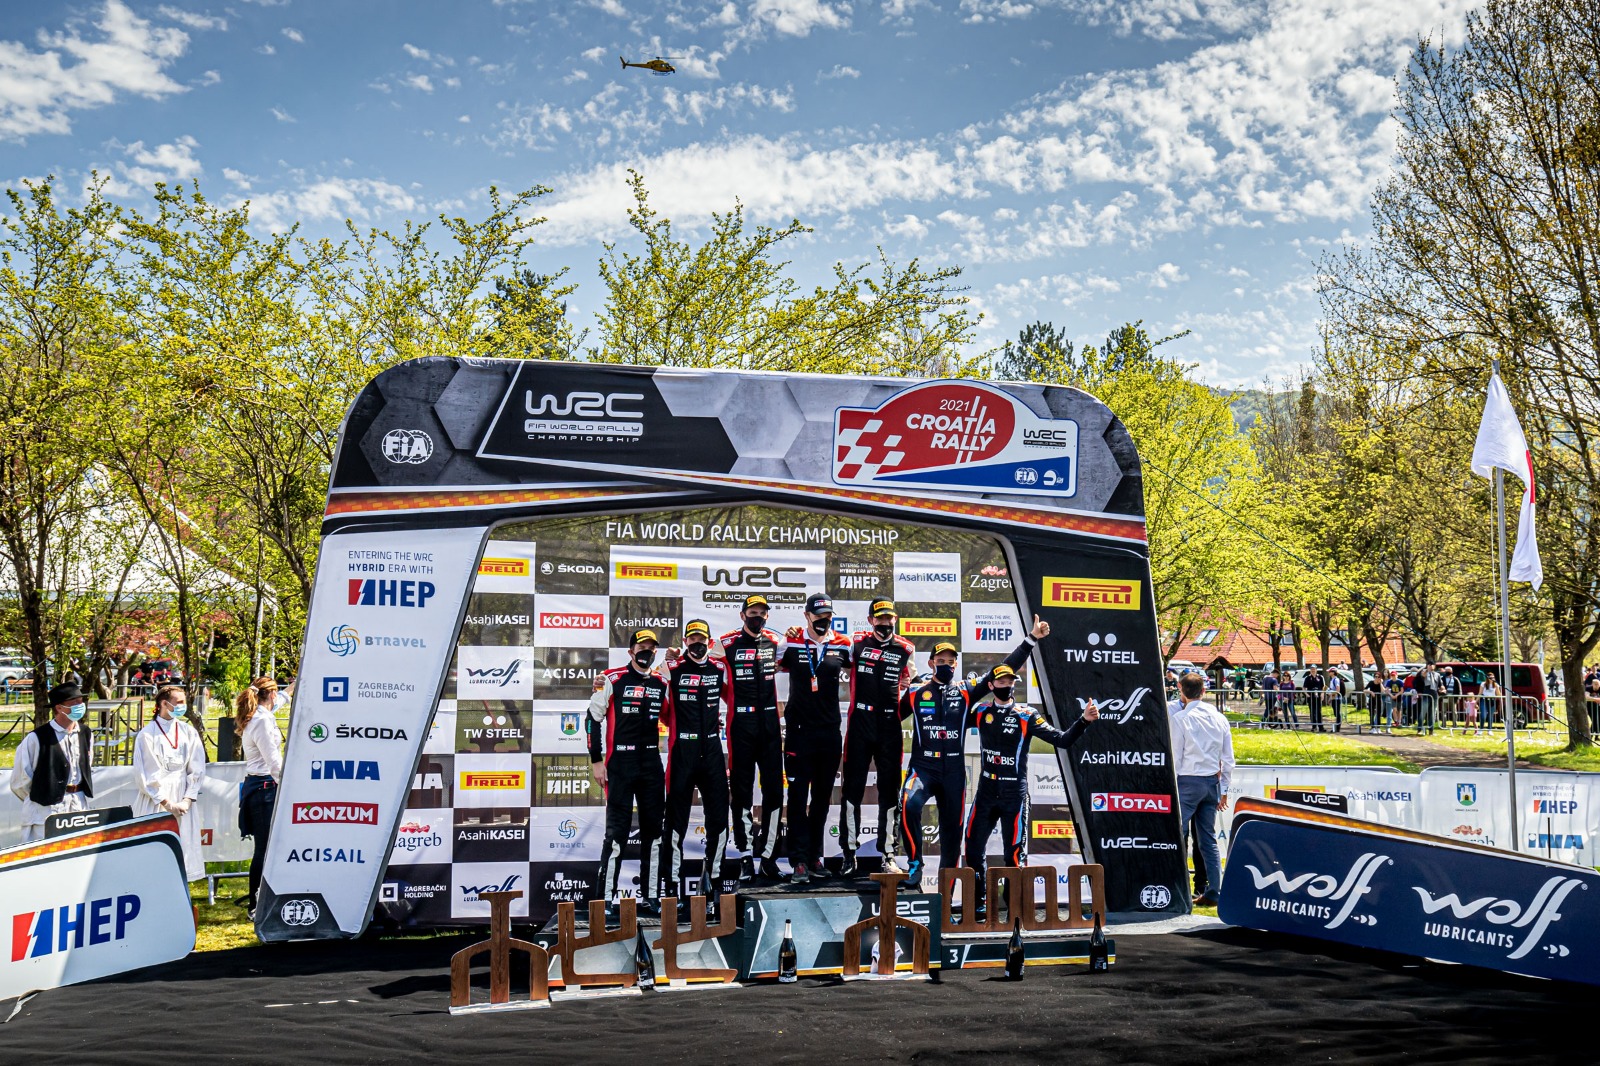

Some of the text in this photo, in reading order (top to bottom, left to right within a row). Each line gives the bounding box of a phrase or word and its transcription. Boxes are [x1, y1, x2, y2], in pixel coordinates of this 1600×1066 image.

[525, 390, 645, 418] WRC
[939, 399, 970, 412] 2021
[528, 422, 641, 433] FIA WORLD RALLY
[906, 413, 996, 434] CROATIA
[527, 434, 640, 443] CHAMPIONSHIP
[1023, 428, 1067, 441] WRC
[930, 433, 996, 452] RALLY
[606, 522, 899, 545] FIA WORLD RALLY CHAMPIONSHIP
[348, 550, 433, 562] ENTERING THE WRC
[348, 563, 433, 574] HYBRID ERA WITH
[479, 561, 524, 573] IRELLI
[558, 564, 604, 574] ŠKODA
[621, 565, 672, 577] PIRELLI
[702, 565, 806, 587] WRC
[854, 576, 879, 589] HEP
[899, 572, 956, 582] AsahiKASEI
[379, 580, 436, 608] HEP
[1052, 582, 1132, 604] PIRELLI
[464, 615, 530, 625] AsahiKASEI
[543, 616, 600, 627] KONZUM
[615, 618, 678, 628] AsahiKASEI
[905, 622, 952, 632] PIRELLI
[988, 628, 1012, 641] HEP
[1064, 649, 1140, 664] TW STEEL
[358, 682, 414, 692] ZAGREBAČKI
[358, 691, 398, 699] HOLDING
[336, 724, 408, 740] ŠKODA
[464, 729, 524, 738] TW STEEL
[930, 730, 958, 740] MOBIS
[987, 754, 1014, 766] MOBIS
[1080, 751, 1165, 766] AsahiKASEI
[466, 774, 520, 787] PIRELLI
[562, 780, 590, 794] HEP
[1110, 795, 1168, 810] TOTAL
[1302, 793, 1340, 806] WRC
[1347, 790, 1412, 802] AsahiKASEI
[1548, 800, 1578, 814] HEP
[297, 806, 373, 822] KONZUM
[56, 814, 100, 829] WRC
[458, 830, 525, 840] AsahiKASEI
[394, 833, 442, 852] agreb
[287, 848, 365, 864] ACISAIL
[746, 906, 754, 922] 1
[1256, 896, 1331, 920] LUBRICANTS
[58, 894, 141, 952] HEP
[1424, 922, 1514, 948] LUBRICANTS
[950, 949, 958, 964] 3
